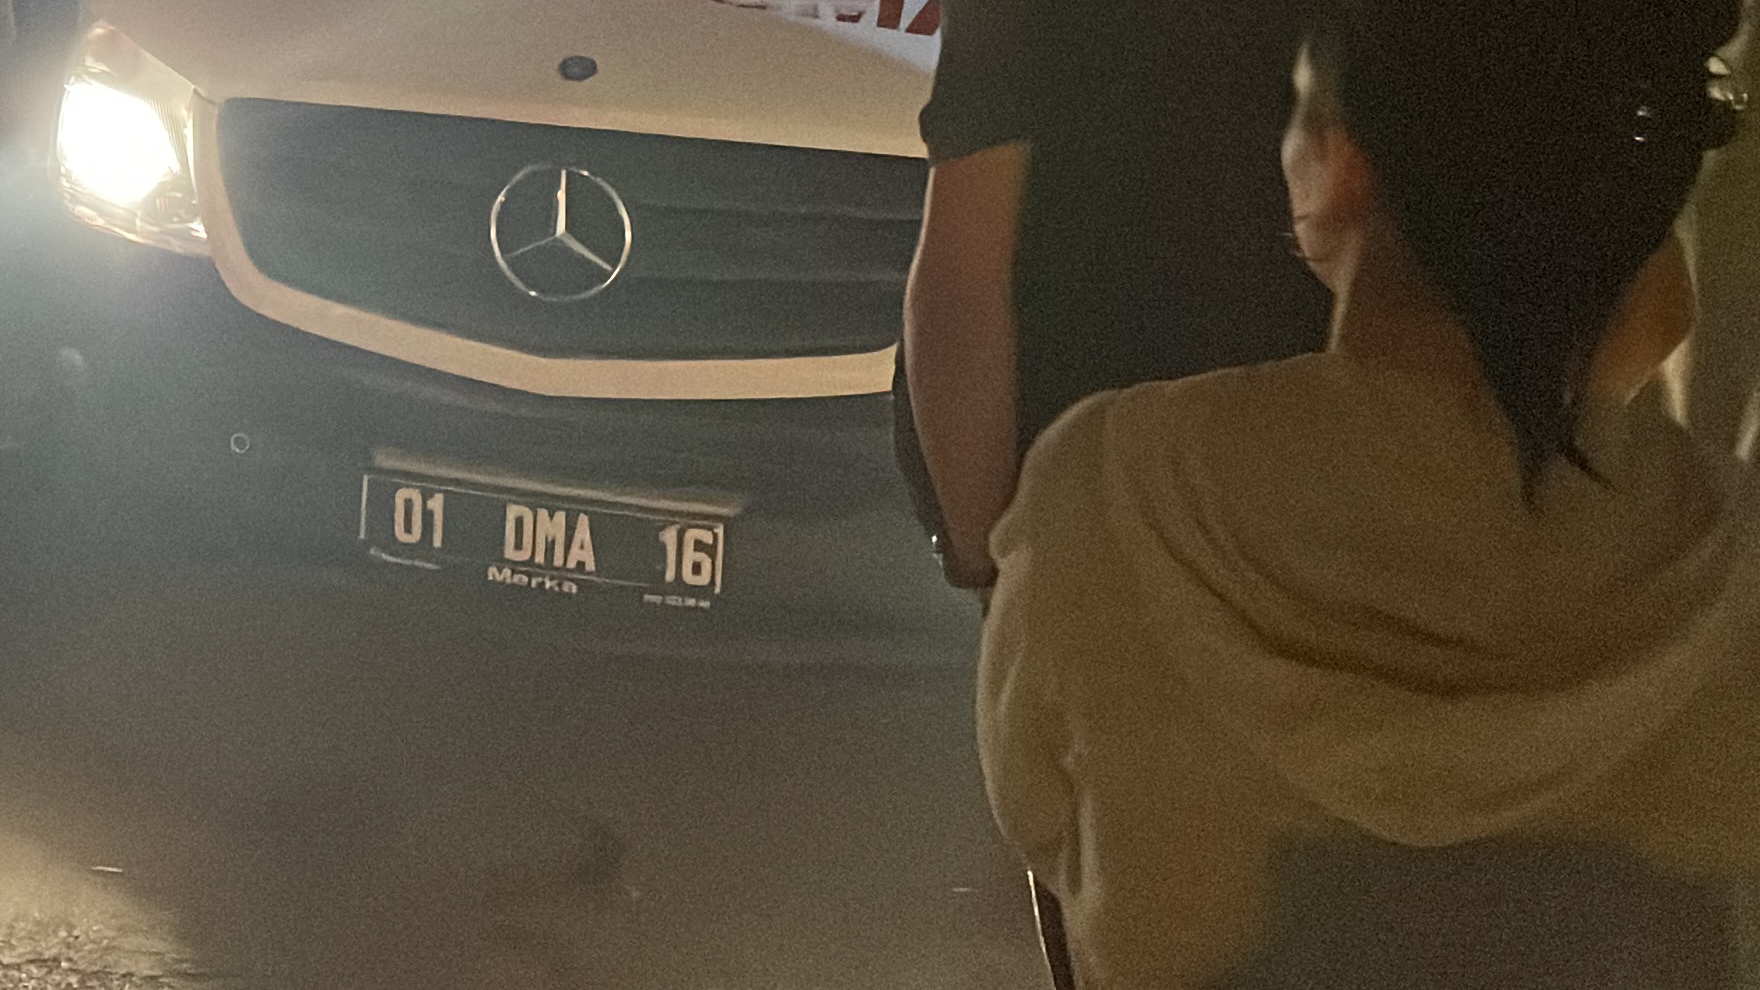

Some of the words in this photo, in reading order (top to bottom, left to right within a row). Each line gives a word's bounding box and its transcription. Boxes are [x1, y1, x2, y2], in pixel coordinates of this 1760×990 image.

[394, 487, 444, 548] 01
[504, 503, 596, 572] DMA
[659, 524, 713, 587] 16
